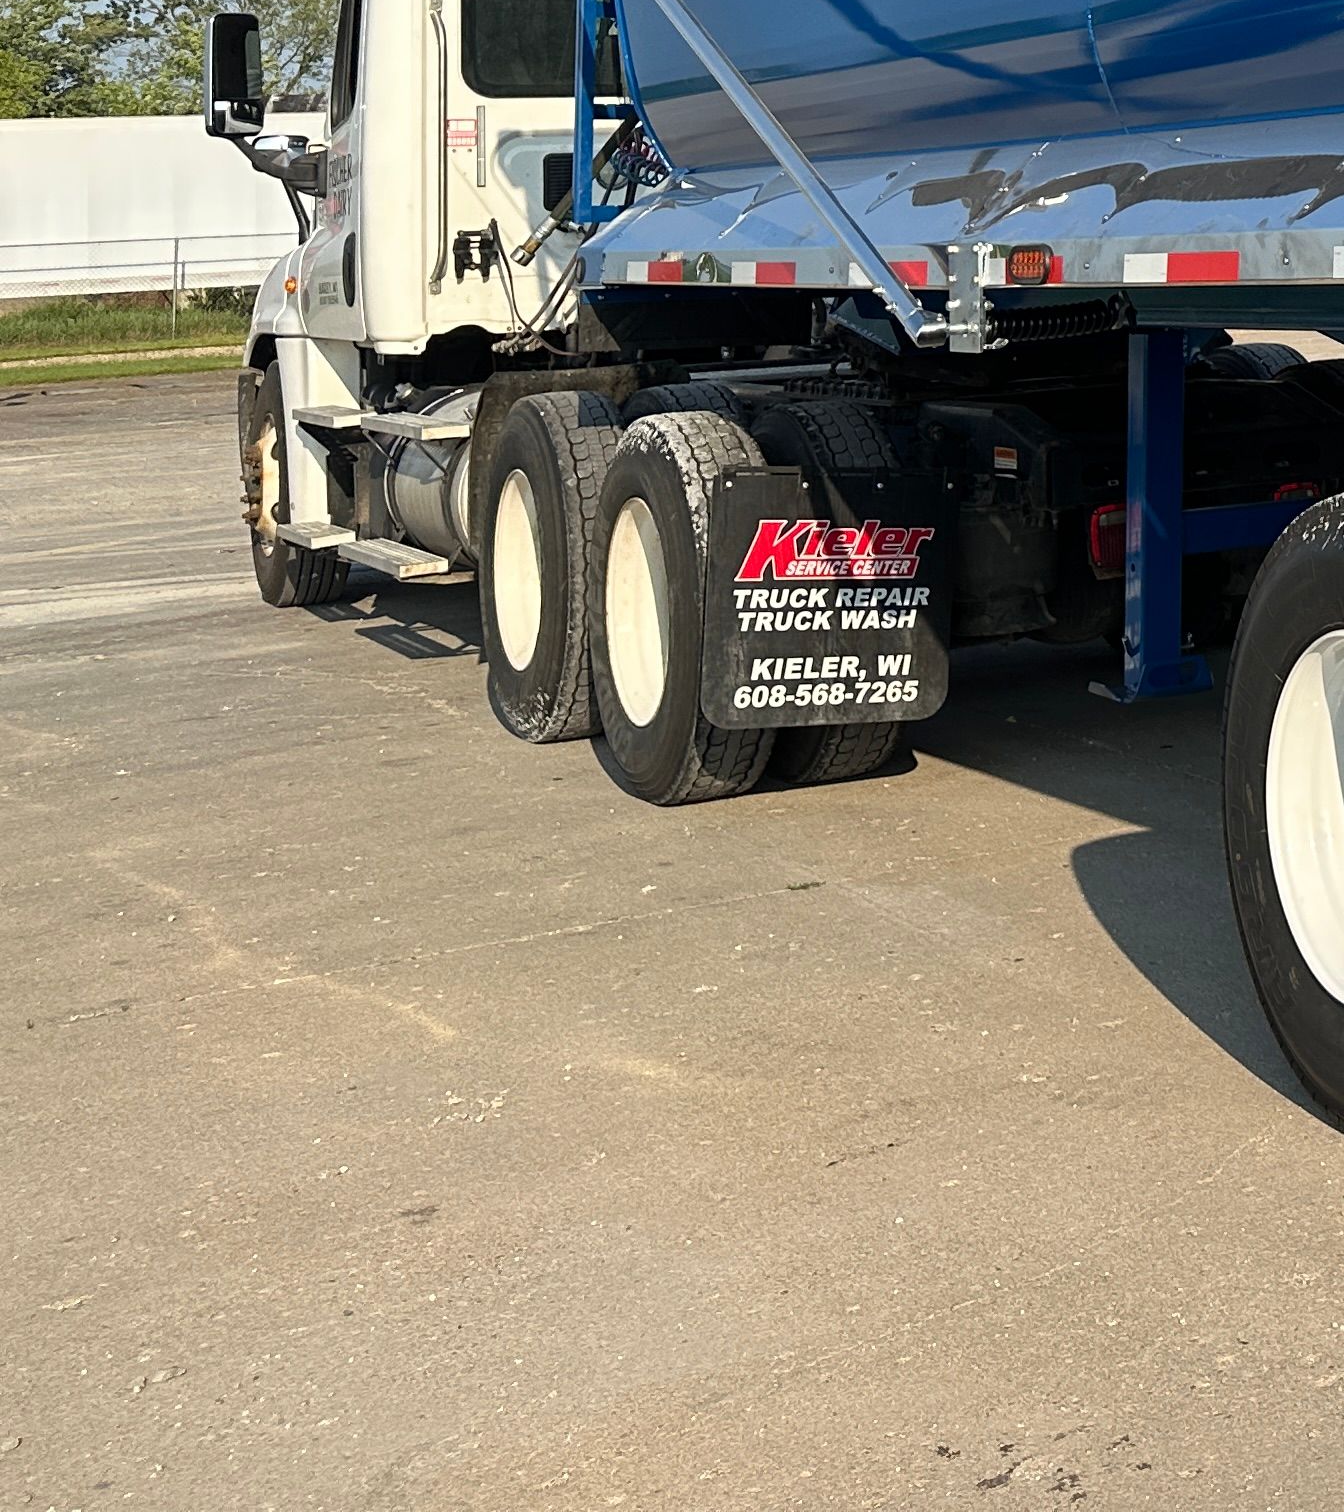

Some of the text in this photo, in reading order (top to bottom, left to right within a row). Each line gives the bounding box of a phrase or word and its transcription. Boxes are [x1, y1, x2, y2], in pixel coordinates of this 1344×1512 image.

[733, 519, 936, 582] Kieler
[785, 559, 911, 576] SERVICE CENTER
[733, 586, 930, 609] TRUCK REPAIR
[737, 608, 918, 632] TRUCK WASH
[750, 654, 912, 682] KIELER, WI
[733, 679, 919, 709] 608-568-7265
